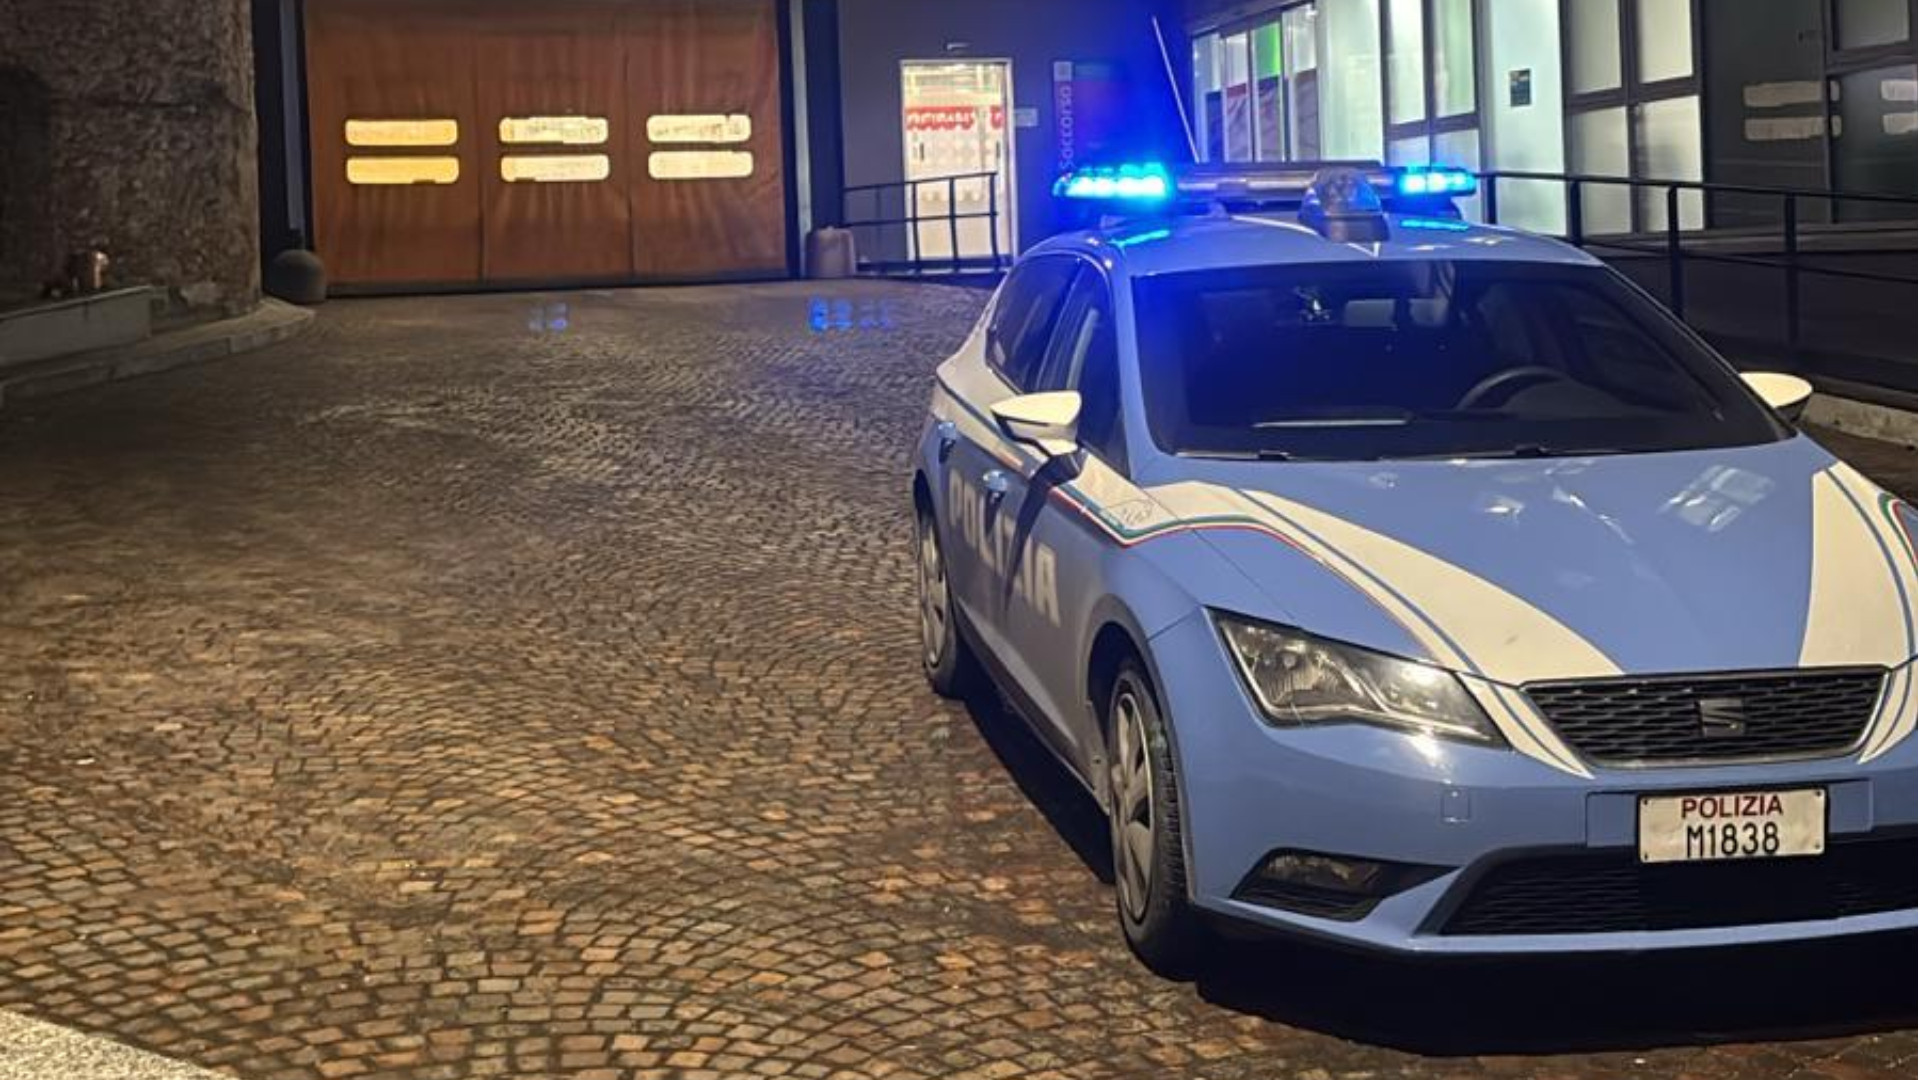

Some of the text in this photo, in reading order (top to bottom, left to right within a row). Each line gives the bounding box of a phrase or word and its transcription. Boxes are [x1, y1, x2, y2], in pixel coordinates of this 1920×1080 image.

[1058, 86, 1075, 170] Soccorso
[1681, 795, 1783, 819] POLIZIA
[1686, 821, 1780, 859] M1838
